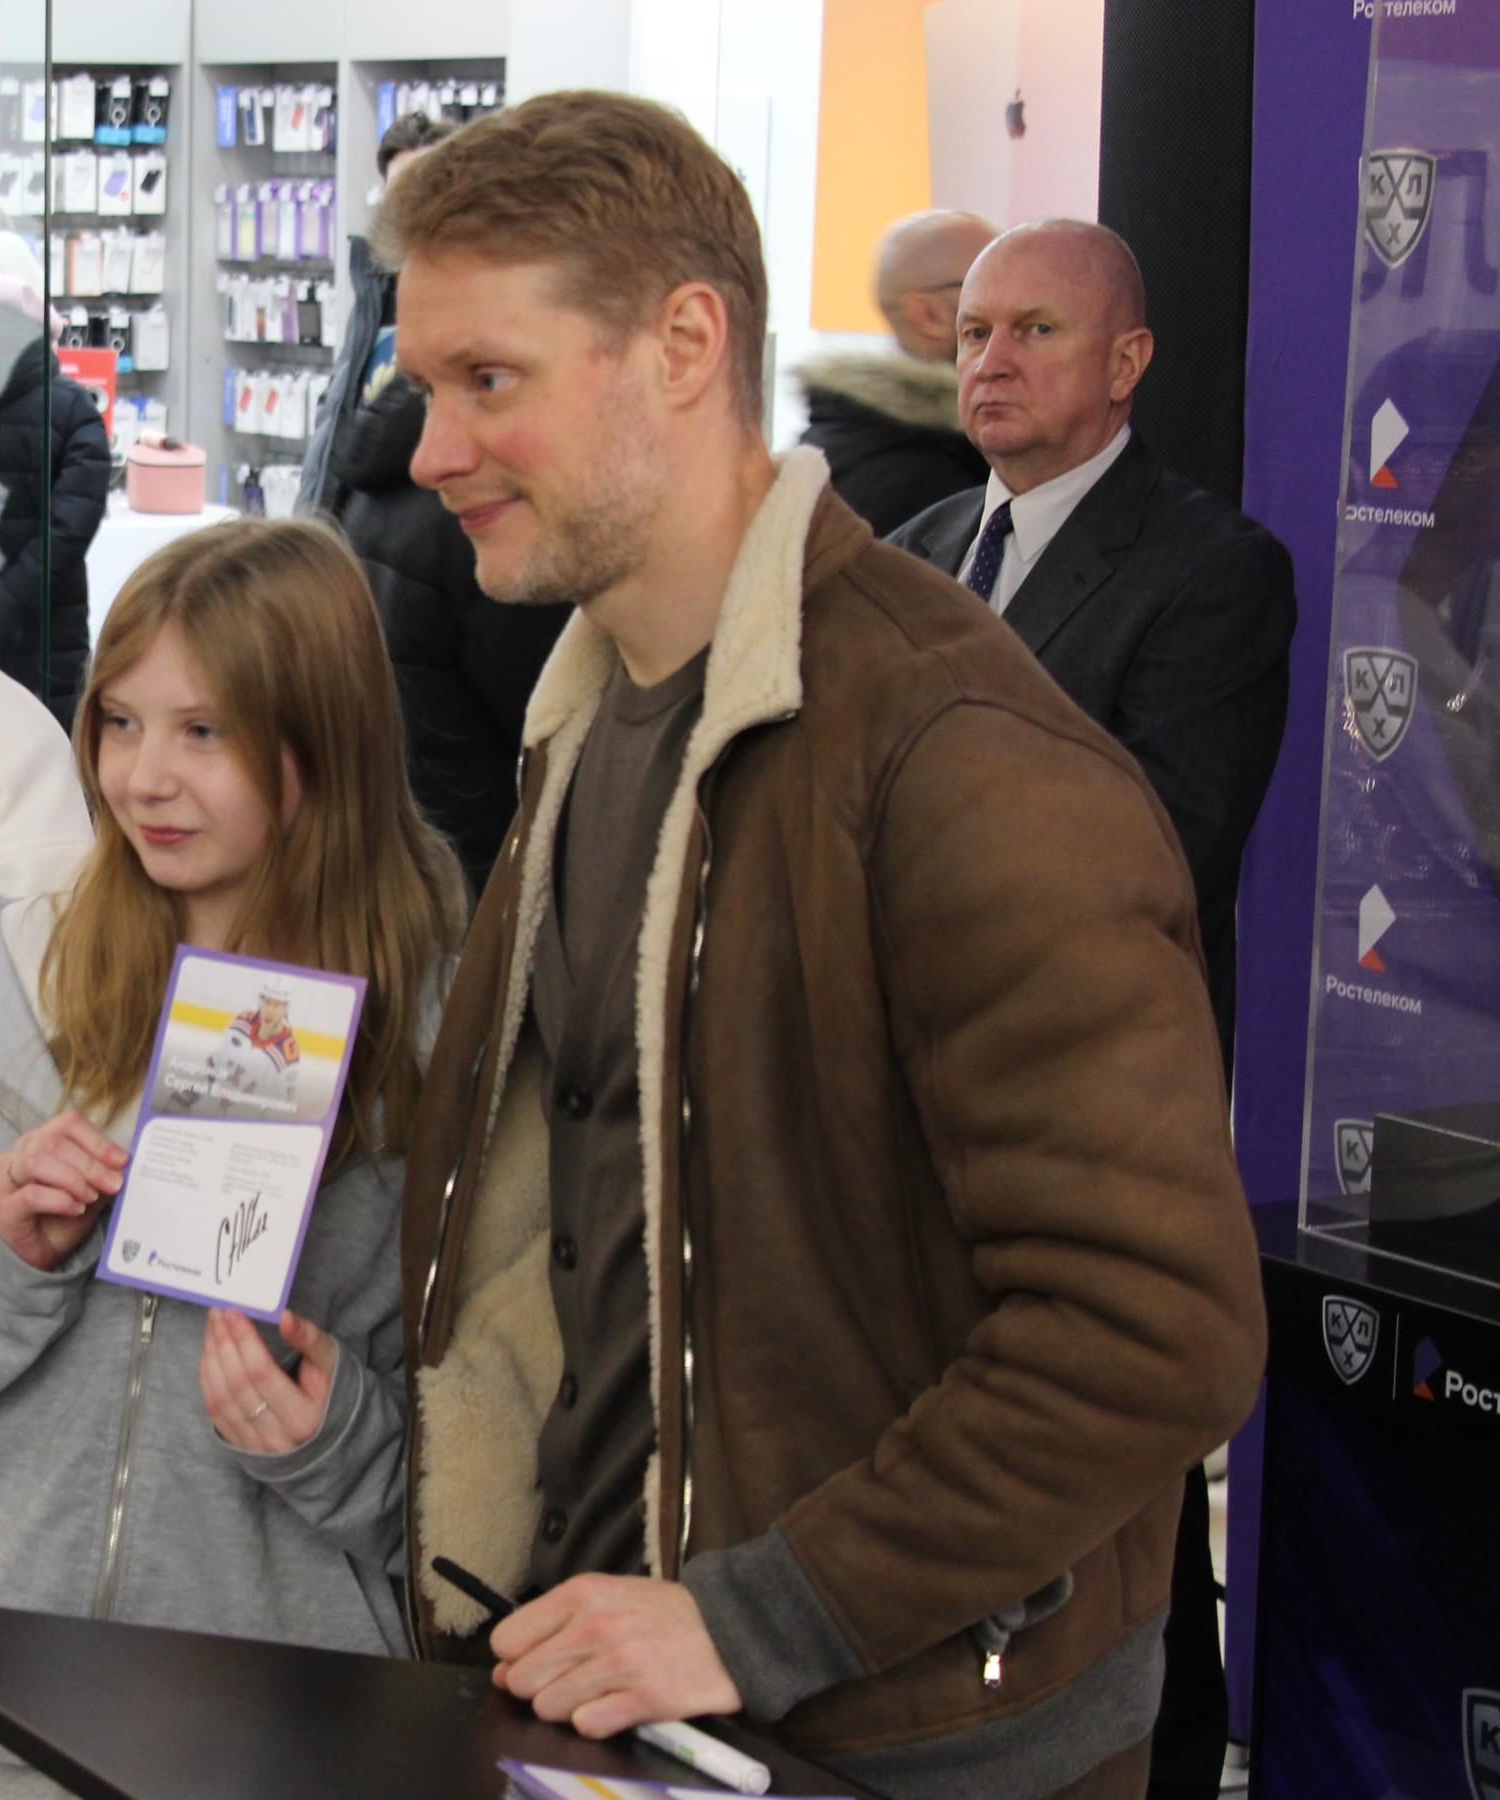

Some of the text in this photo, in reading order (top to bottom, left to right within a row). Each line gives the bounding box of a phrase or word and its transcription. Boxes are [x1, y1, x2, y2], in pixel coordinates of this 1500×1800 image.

[1353, 0, 1457, 19] Ротелеком
[1337, 499, 1435, 528] остелеком
[1325, 974, 1422, 1015] Ростелеком
[164, 1073, 210, 1095] Сергей
[1444, 1369, 1500, 1416] Рост
